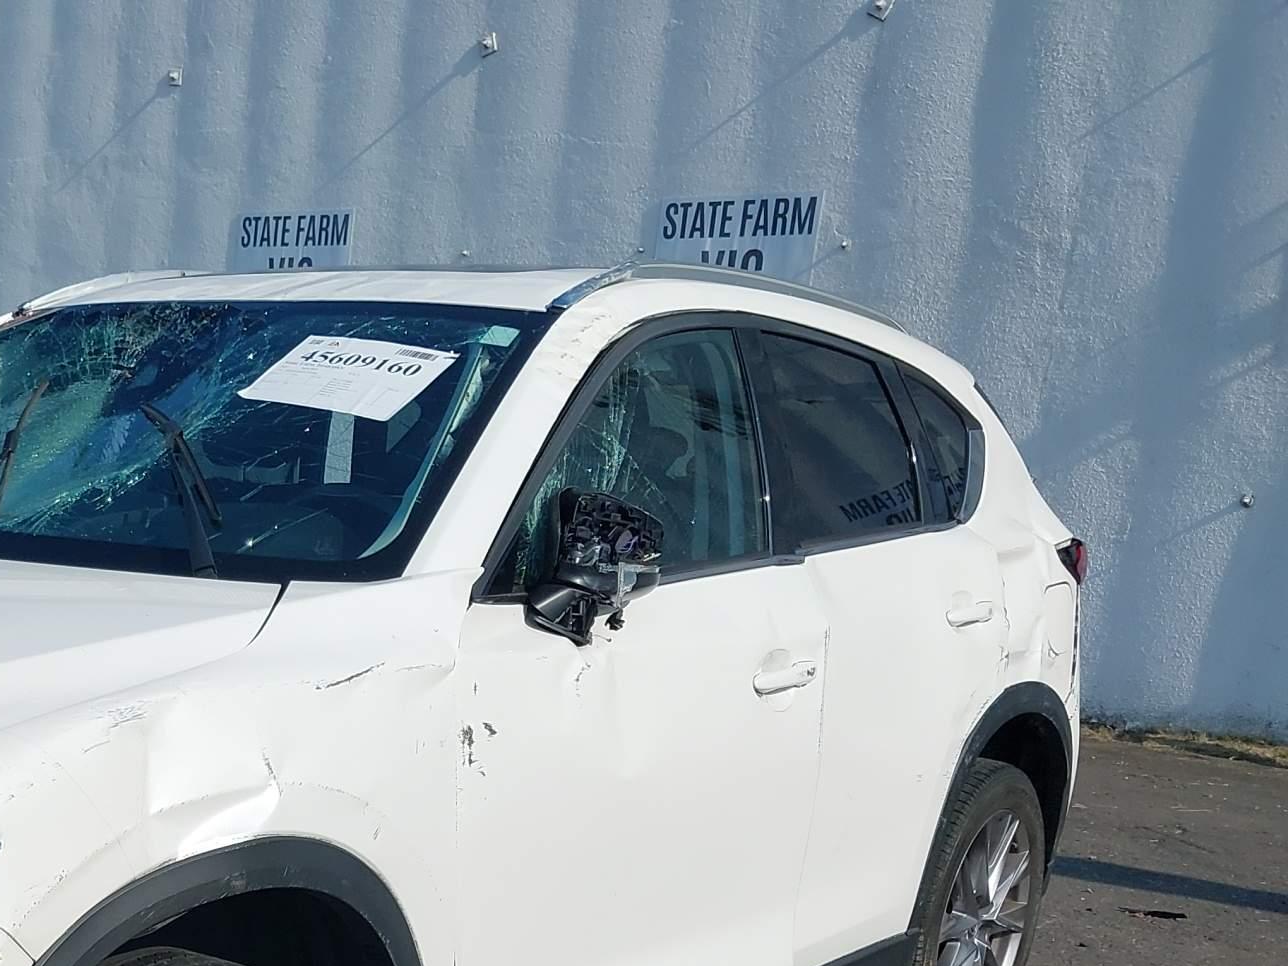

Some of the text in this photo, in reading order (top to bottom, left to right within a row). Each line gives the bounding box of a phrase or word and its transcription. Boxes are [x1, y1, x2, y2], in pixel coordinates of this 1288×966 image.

[241, 213, 350, 248] STATE FARM
[662, 196, 818, 240] STATE FARM
[301, 350, 423, 377] 45609160
